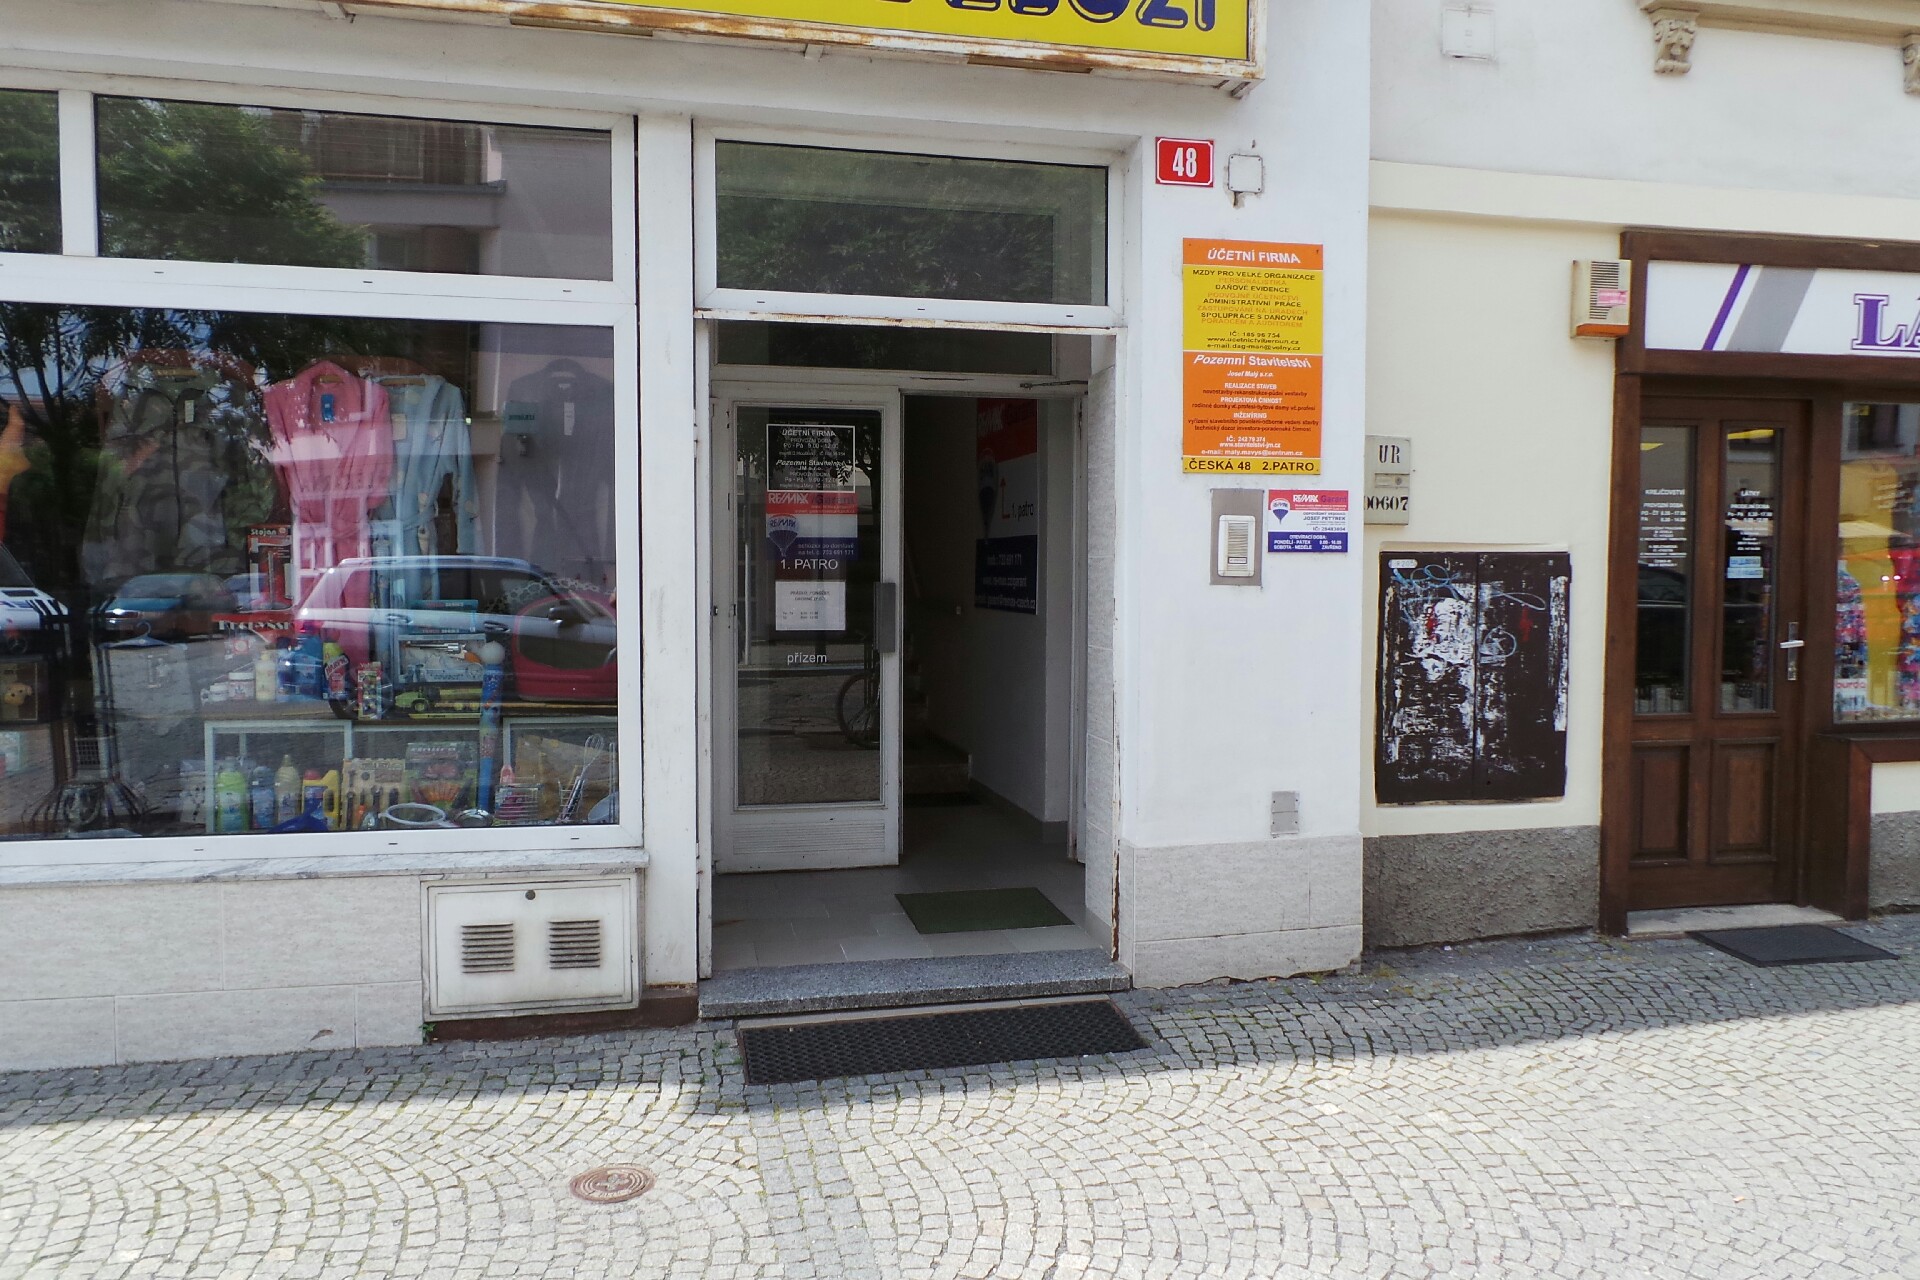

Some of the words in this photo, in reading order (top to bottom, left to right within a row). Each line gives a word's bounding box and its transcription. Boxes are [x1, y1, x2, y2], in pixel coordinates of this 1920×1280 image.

[1172, 147, 1197, 178] 48
[1207, 247, 1255, 262] ÚČETNÍ
[1258, 251, 1301, 264] FIRMA
[1264, 272, 1316, 281] ORGANIZACE
[1215, 283, 1249, 291] DAŇOVÉ
[1250, 285, 1290, 293] EVIDENCE
[1203, 298, 1271, 306] ADMINISTRATIVNÍ
[1274, 300, 1302, 308] PRÁCE
[1201, 311, 1255, 320] SPOLUPRÁCE
[1193, 354, 1246, 366] Pozemní
[1244, 371, 1259, 379] Malý
[811, 429, 837, 437] FIRMA
[1379, 445, 1401, 464] UR
[1188, 458, 1234, 471] ČESKÁ
[1237, 461, 1251, 471] 48
[1262, 461, 1315, 472] 2.PATRO
[768, 493, 809, 504] RE/MAX
[1292, 494, 1319, 503] RE/MAX
[1017, 502, 1035, 522] patro
[250, 528, 277, 536] stojan
[780, 559, 791, 570] 1.
[794, 558, 839, 570] PATRO
[1835, 680, 1866, 689] burda
